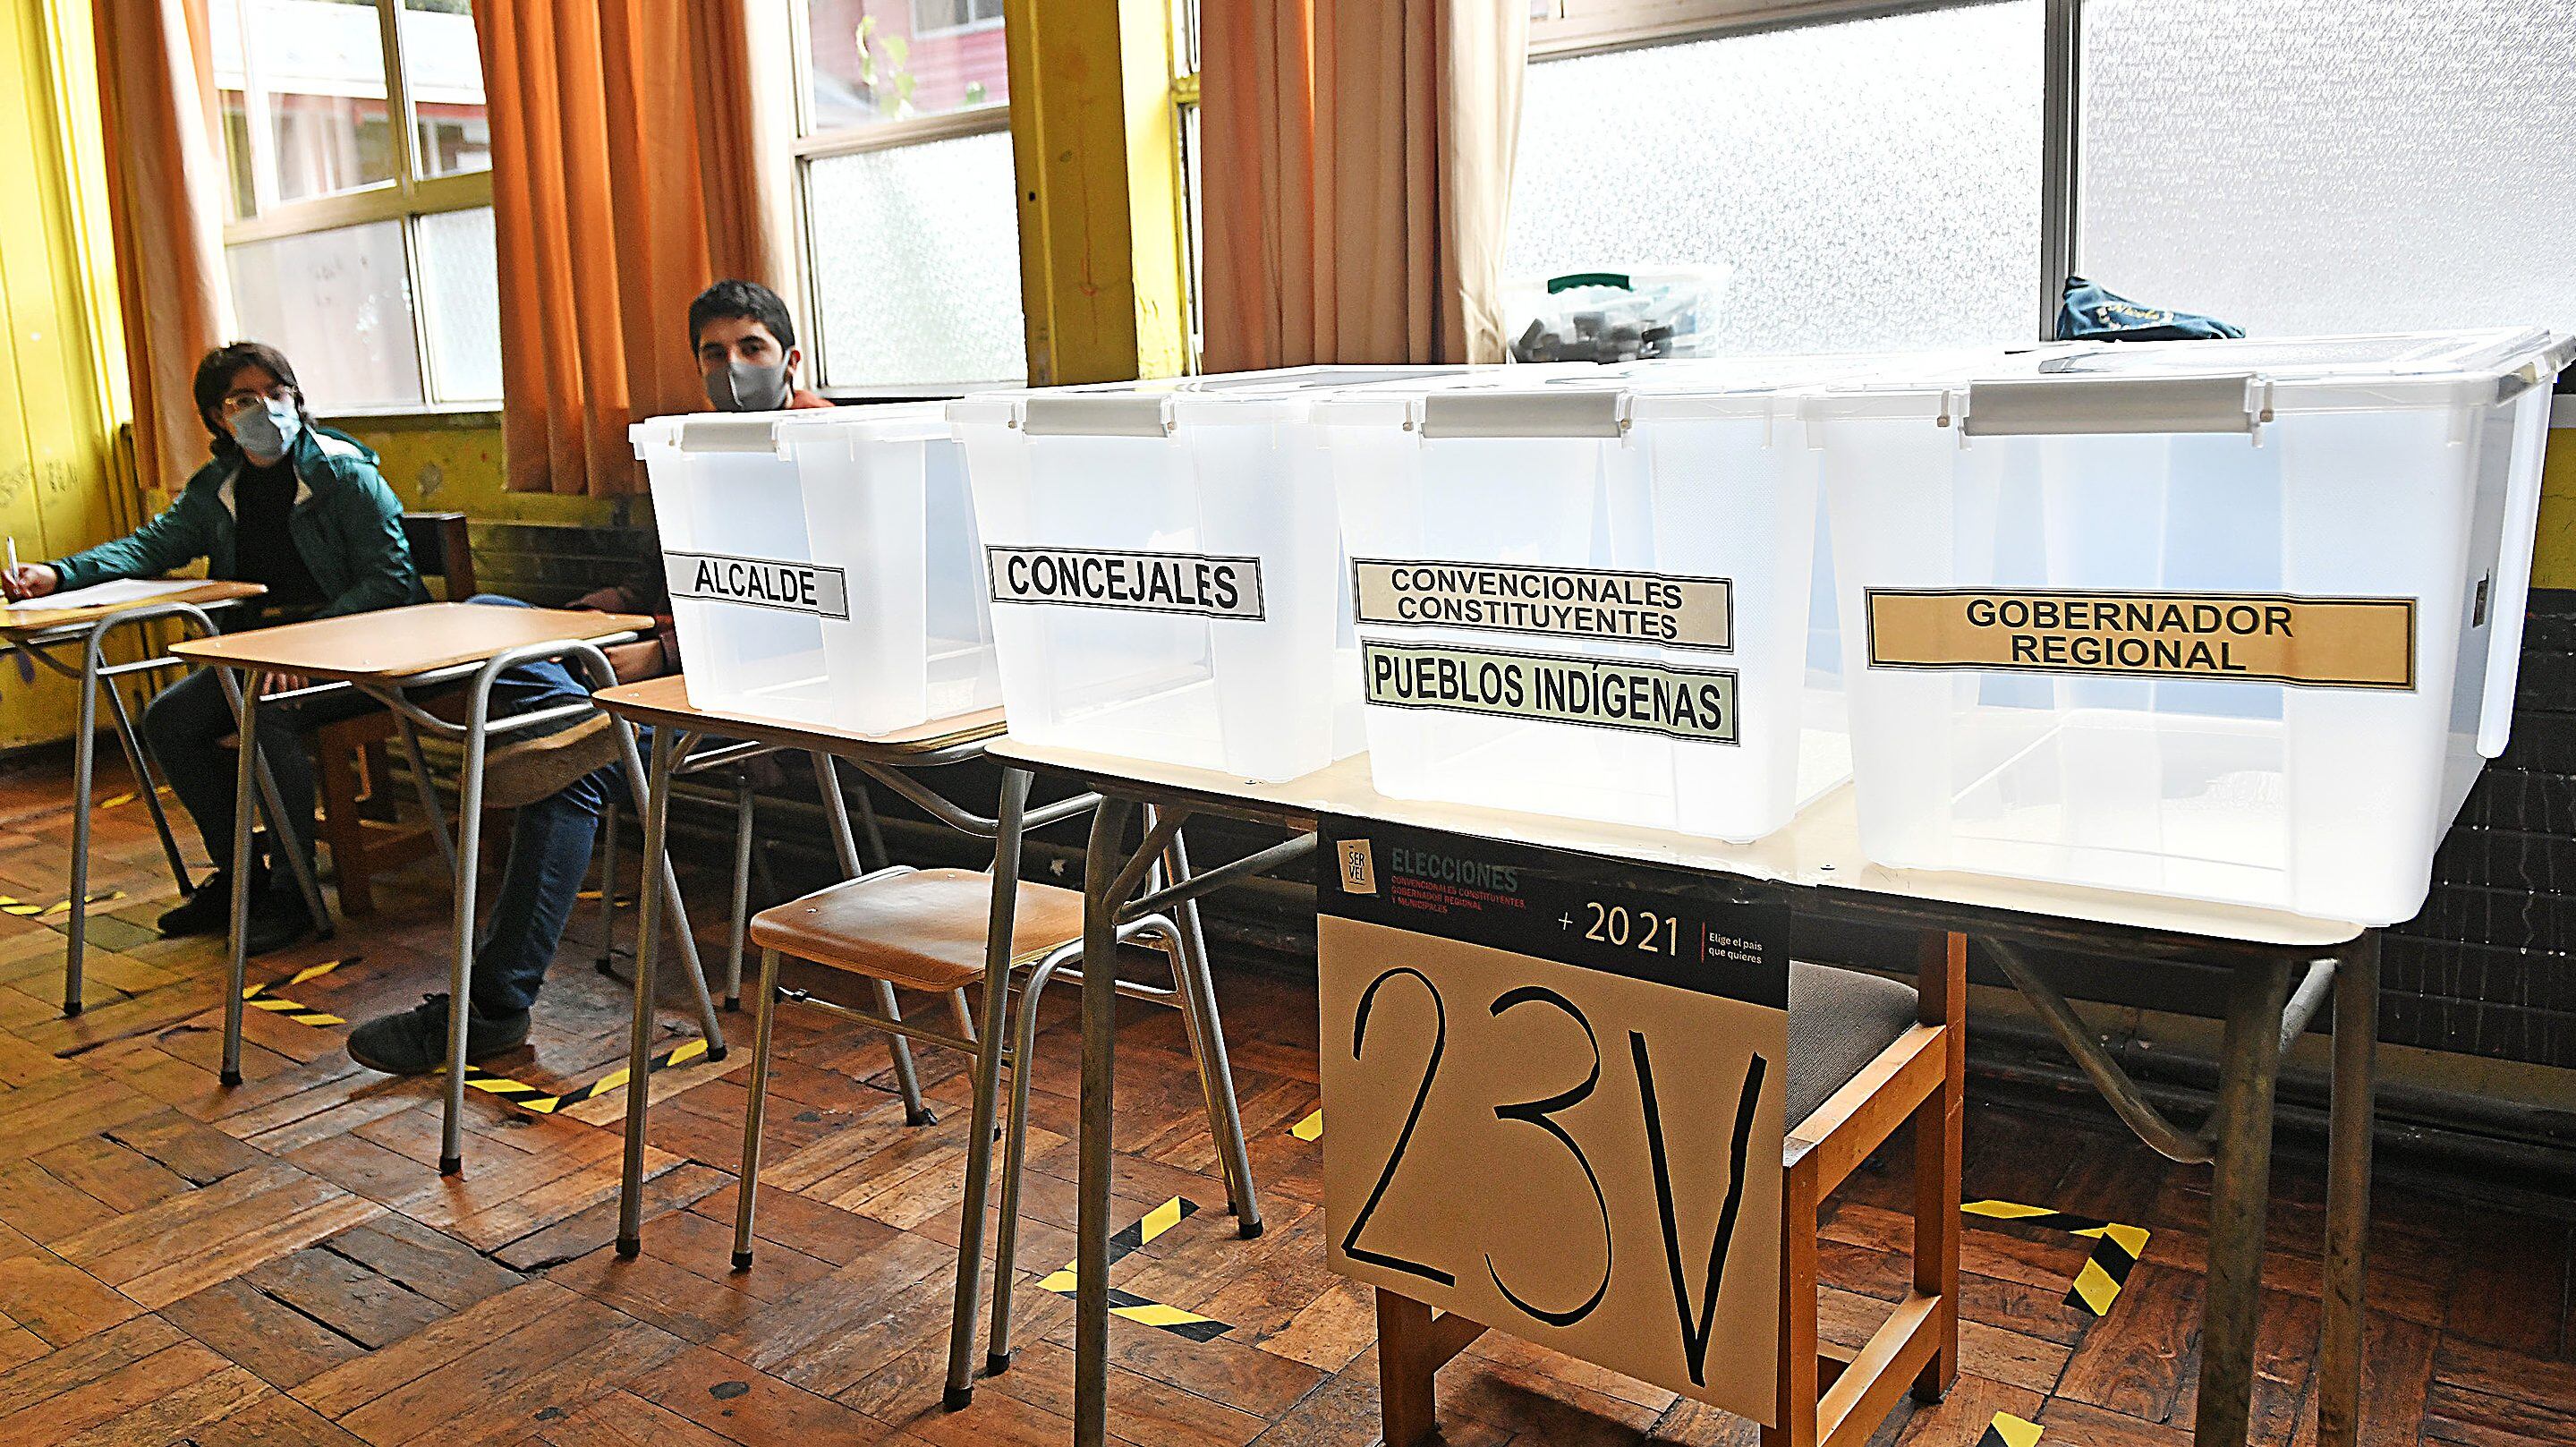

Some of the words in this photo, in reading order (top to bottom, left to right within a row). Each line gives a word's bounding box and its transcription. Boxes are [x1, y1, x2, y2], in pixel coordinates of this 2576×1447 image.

[695, 558, 818, 606] ALCALDE
[1007, 555, 1239, 609] CONCEJALES
[1390, 568, 1683, 610] CONVENCIONALES
[1398, 596, 1679, 640] CONSTITUYENTES
[1966, 599, 2294, 637] GOBERNADOR
[2011, 635, 2247, 671] REGIONAL
[1374, 654, 1524, 708] PUEBLOS
[1533, 663, 1722, 732] INDÍGENAS
[1348, 852, 1365, 866] SER
[1349, 866, 1365, 881] VEL
[1392, 848, 1518, 892] ELECCIONES
[1391, 876, 1457, 895] CONVENCIONALES
[1391, 887, 1443, 903] GOBERNADOR
[1444, 896, 1482, 911] REGIONAL
[1399, 898, 1448, 914] MUNICIPALES
[1586, 902, 1677, 956] 2021
[1709, 932, 1731, 947] Elige
[1733, 937, 1741, 947] el
[1708, 947, 1725, 958] que
[1727, 949, 1762, 964] quieres
